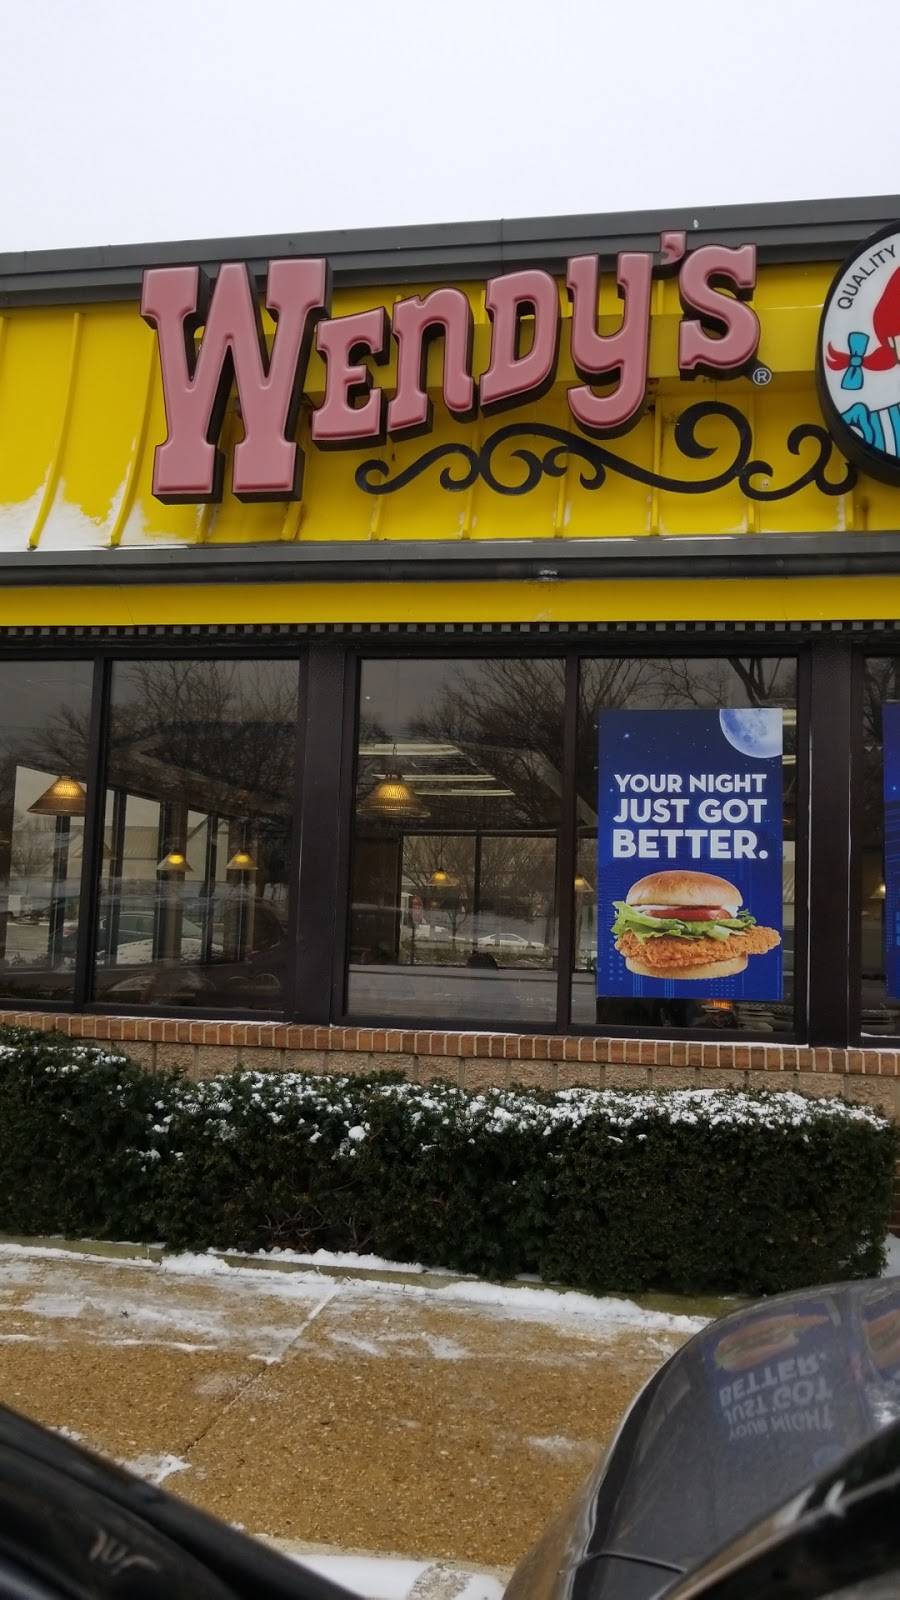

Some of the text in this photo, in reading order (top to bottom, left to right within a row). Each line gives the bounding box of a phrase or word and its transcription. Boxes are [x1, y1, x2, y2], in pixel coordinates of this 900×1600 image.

[837, 244, 897, 310] QUALITY
[614, 774, 767, 793] YOUR NIGHT
[613, 798, 768, 823] JUST GOT
[612, 829, 769, 860] BETTER.
